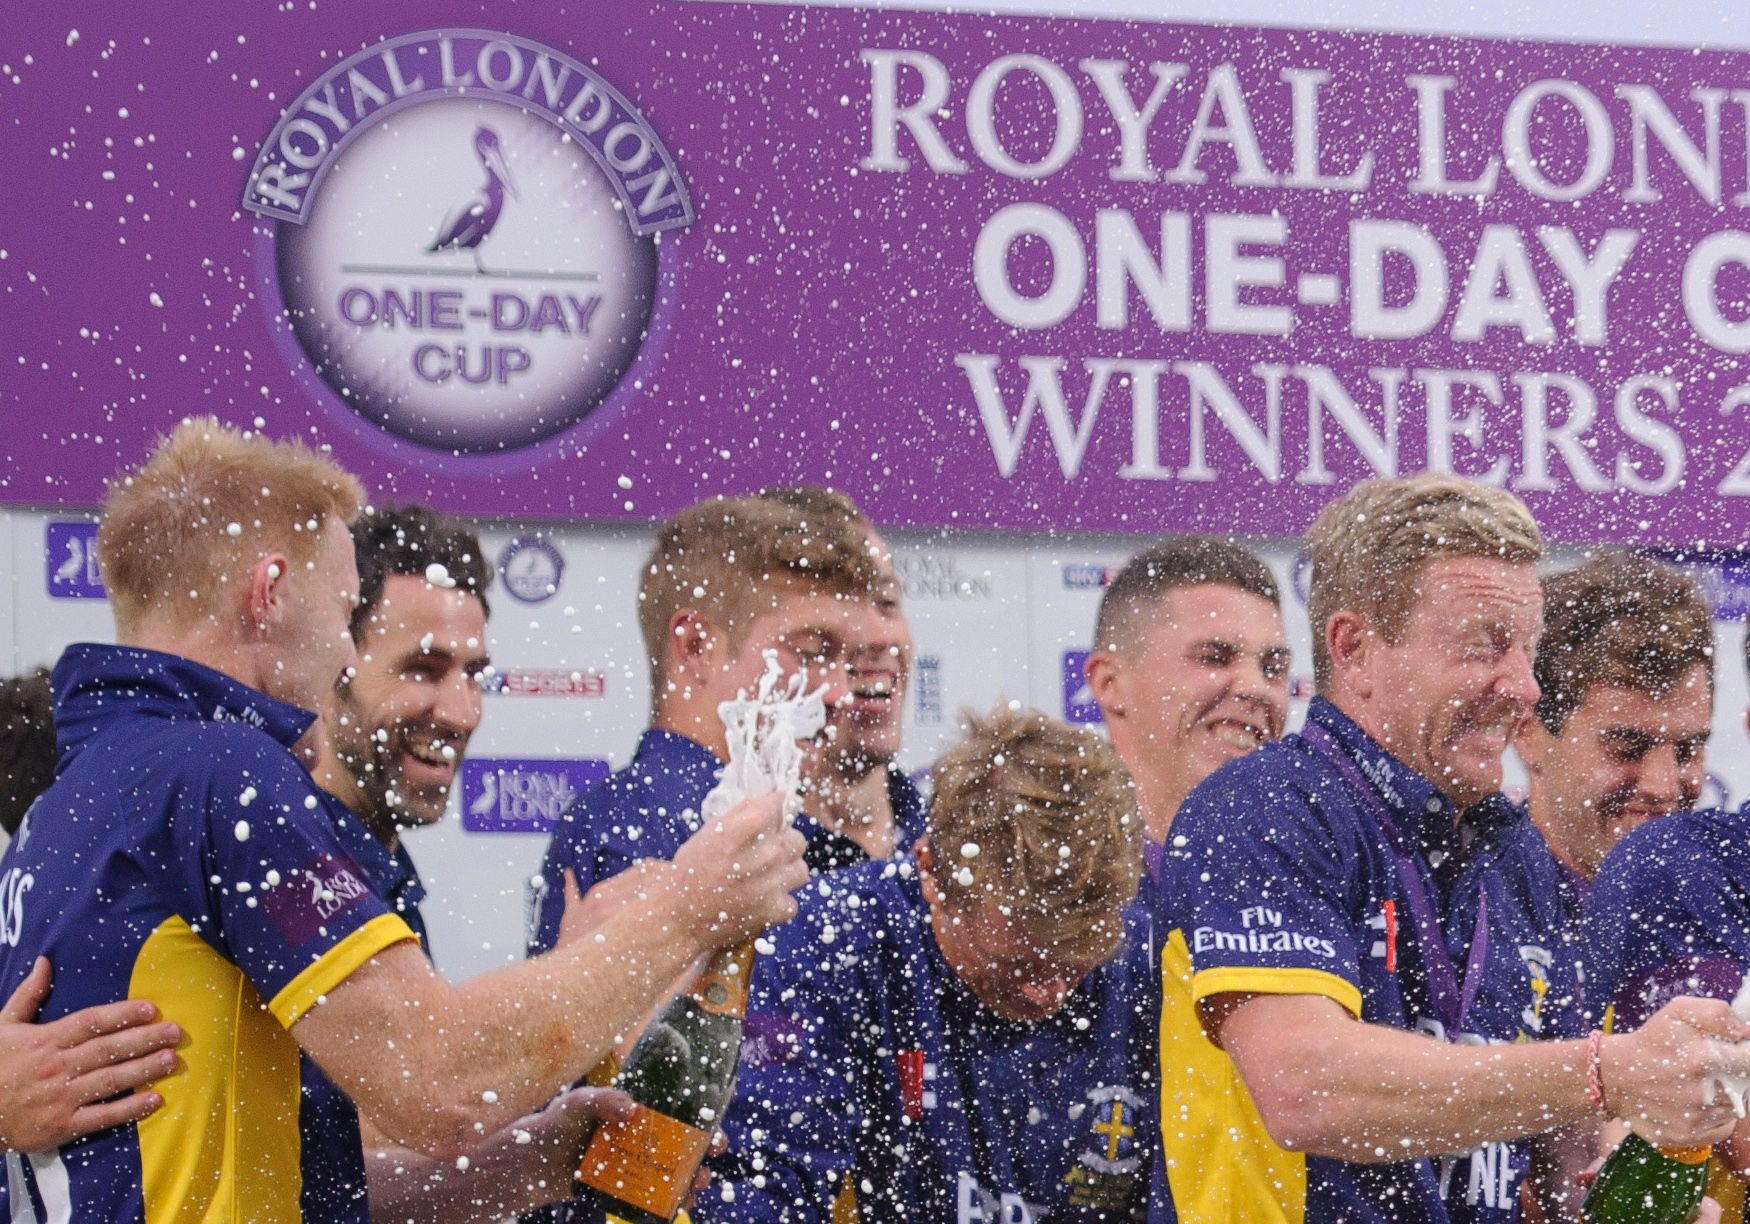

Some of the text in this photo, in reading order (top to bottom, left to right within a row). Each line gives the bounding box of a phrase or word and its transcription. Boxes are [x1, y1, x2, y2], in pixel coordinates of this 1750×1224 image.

[259, 39, 680, 222] ROYAL LONDON
[859, 46, 1376, 191] ROYAL
[972, 201, 1640, 346] ONE-DAY
[338, 286, 603, 334] ONE-DAY
[411, 344, 531, 386] CUP
[954, 352, 1687, 498] WINNERS
[500, 792, 575, 820] LOND
[1240, 906, 1282, 928] Fly
[1193, 926, 1336, 958] Emirates
